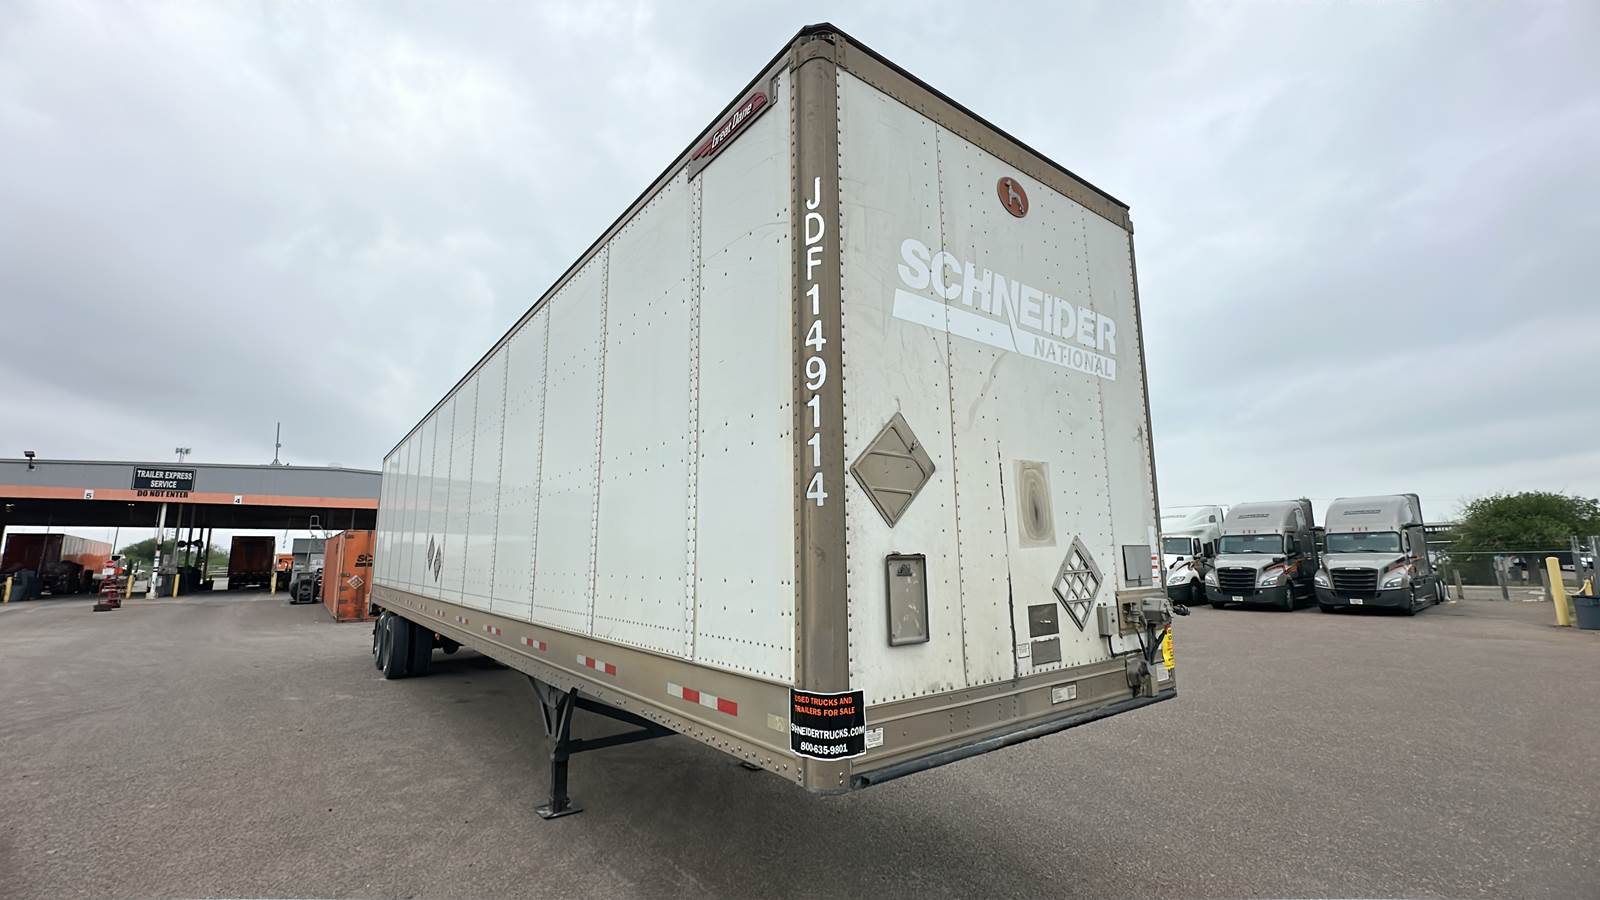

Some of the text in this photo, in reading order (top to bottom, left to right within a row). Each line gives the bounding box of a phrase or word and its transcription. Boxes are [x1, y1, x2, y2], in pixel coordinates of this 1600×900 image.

[897, 238, 1117, 356] SCHNEIDER
[1033, 337, 1113, 378] NATIONAL
[137, 470, 193, 480] TRAILER EXPRESS
[150, 480, 177, 488] SERVICE
[150, 490, 165, 498] NOT
[795, 695, 853, 706] USED TRUCKS AND
[794, 704, 855, 717] TRAILERS FOR SALE
